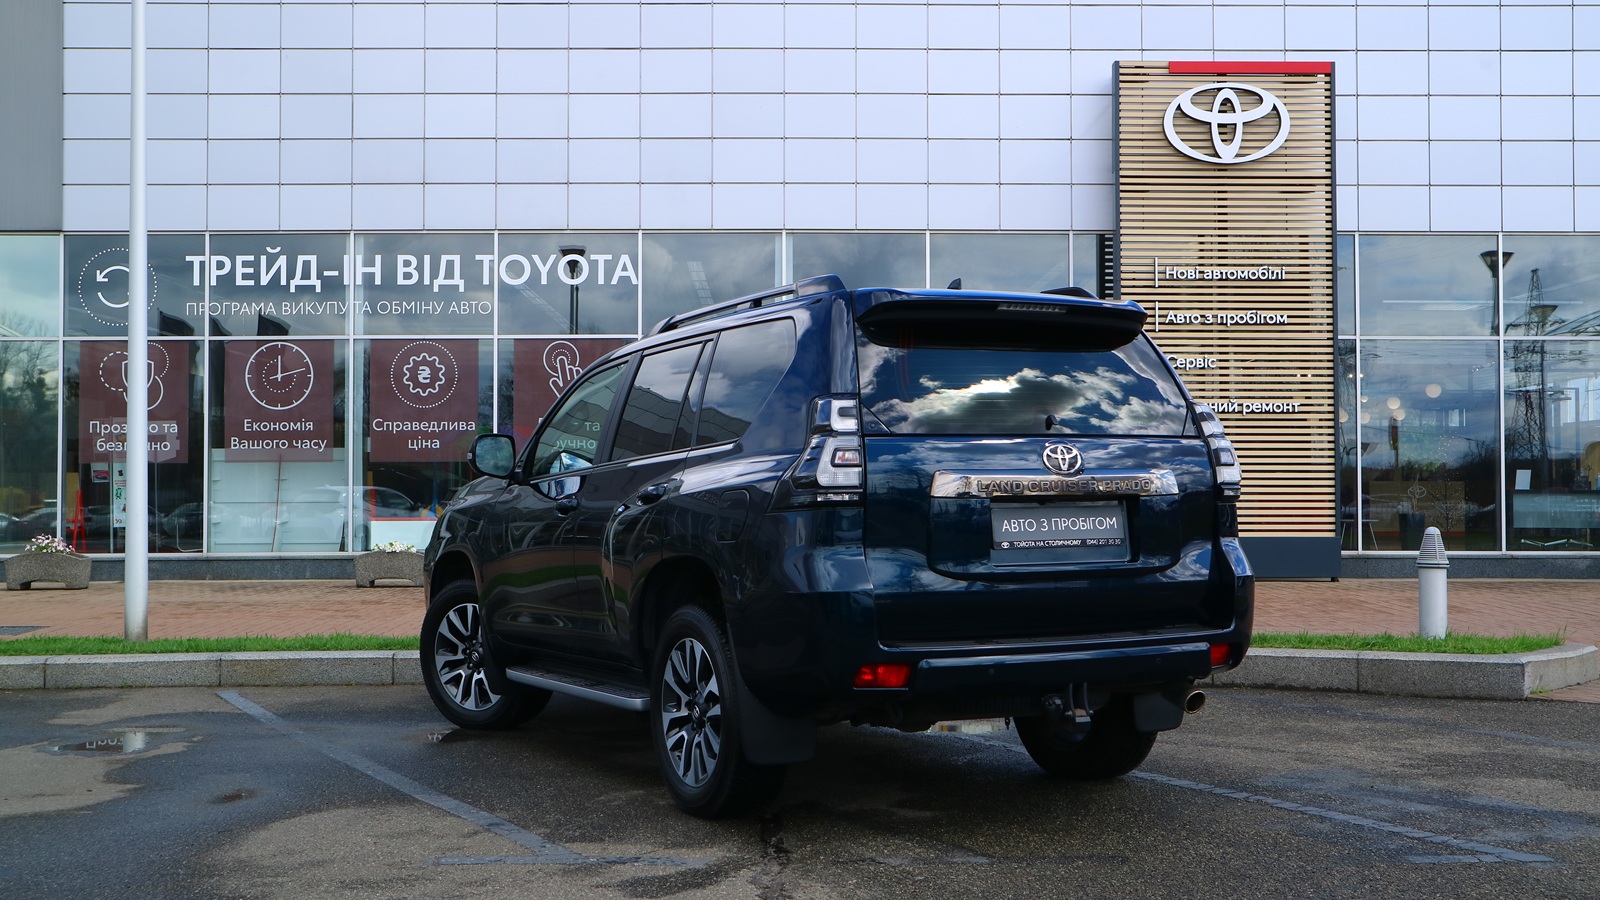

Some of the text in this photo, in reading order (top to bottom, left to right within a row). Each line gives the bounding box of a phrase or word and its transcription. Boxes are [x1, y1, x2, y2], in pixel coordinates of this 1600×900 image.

[185, 246, 639, 293] ТРЕЙД-ІН ВІД TOYOTA
[1165, 266, 1286, 280] Нові автомобілі
[186, 300, 492, 316] ПРОГРАМА ВИКУПУ ТА ОБМІНУ АВТО
[1165, 311, 1288, 327] Авто з пробігом
[1166, 355, 1217, 371] Сервіс
[1242, 402, 1300, 416] ремонт
[89, 420, 178, 436] Прозо та
[243, 418, 314, 431] Економія
[372, 418, 476, 434] Справедлива
[584, 421, 600, 432] та
[96, 438, 171, 452] безно
[230, 437, 327, 452] Вашого часу
[408, 436, 440, 451] ціна
[977, 479, 1151, 494] LAND CRUISER PRADO
[1002, 519, 1036, 533] АВТО
[1051, 516, 1118, 531] ПРОБІГОМ
